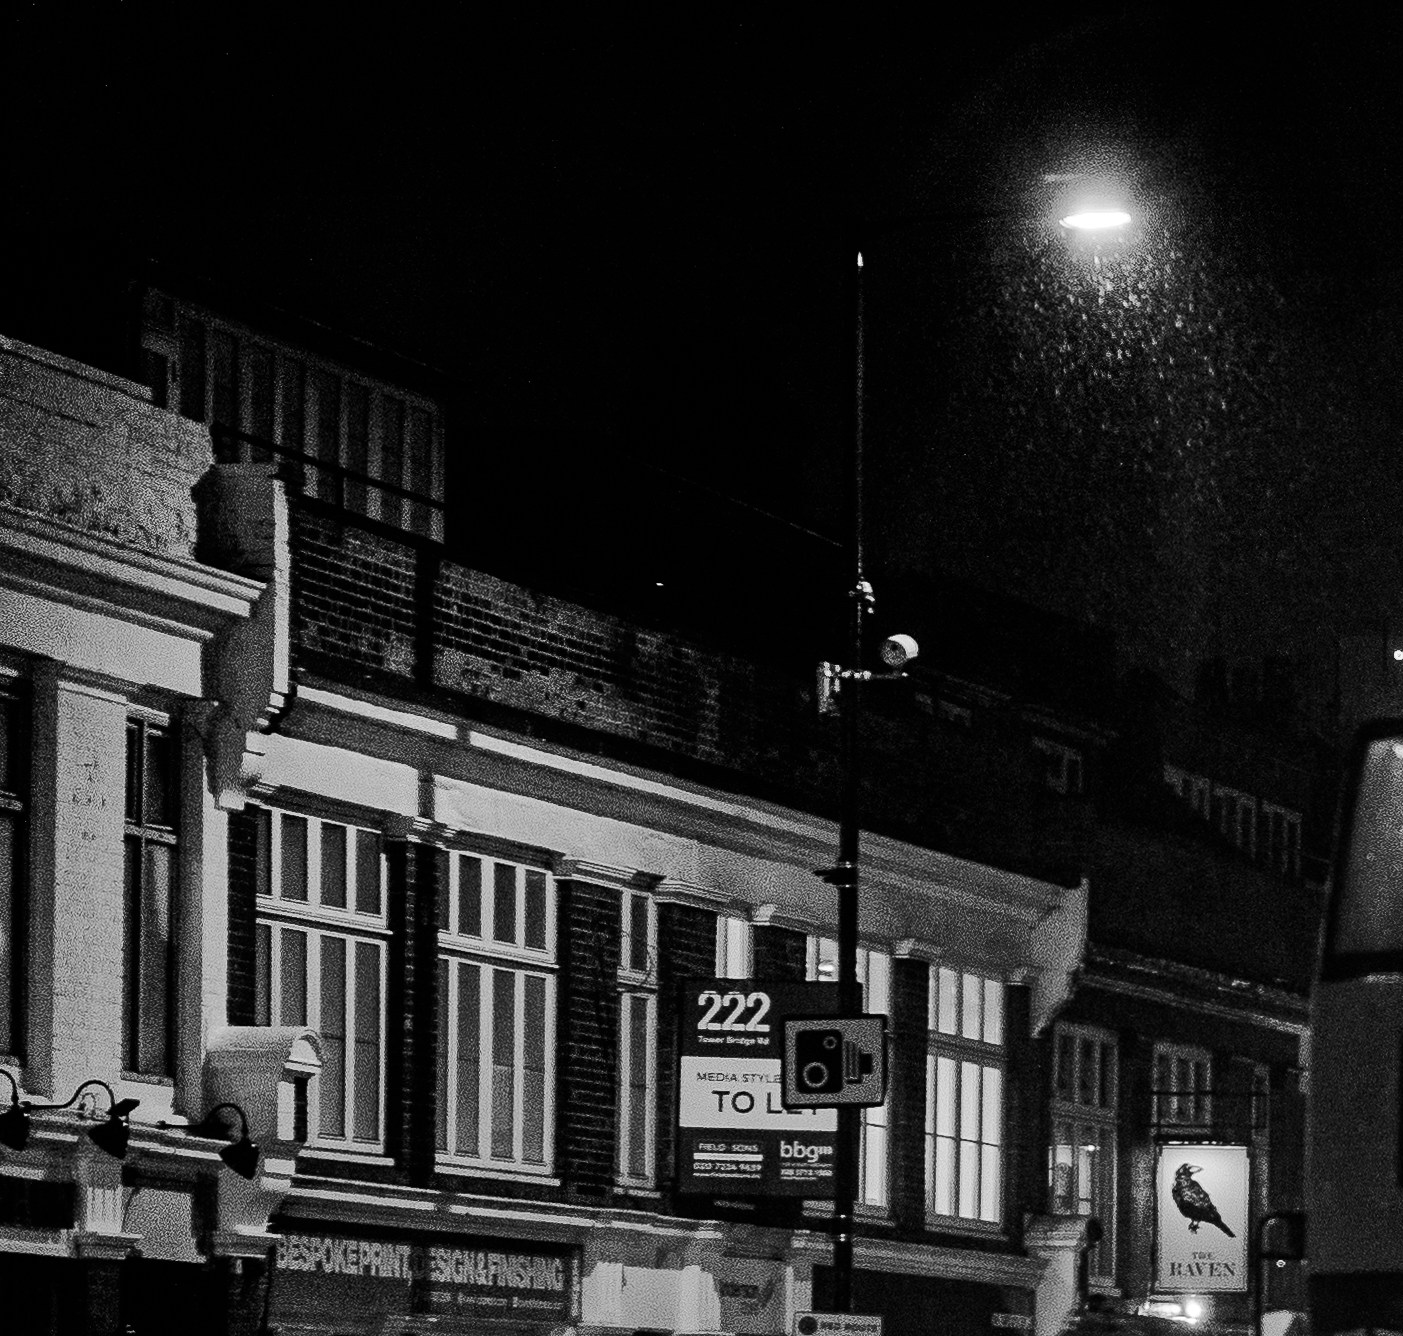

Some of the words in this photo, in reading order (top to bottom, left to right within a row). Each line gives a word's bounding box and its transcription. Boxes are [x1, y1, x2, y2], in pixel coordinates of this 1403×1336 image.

[697, 990, 771, 1032] 222
[726, 1036, 756, 1046] Bridge
[697, 1072, 738, 1083] MEDIA
[711, 1090, 755, 1114] TO
[276, 1234, 358, 1275] BESPOKE
[488, 1251, 564, 1292] FINISHING
[1169, 1262, 1236, 1277] RAVEN
